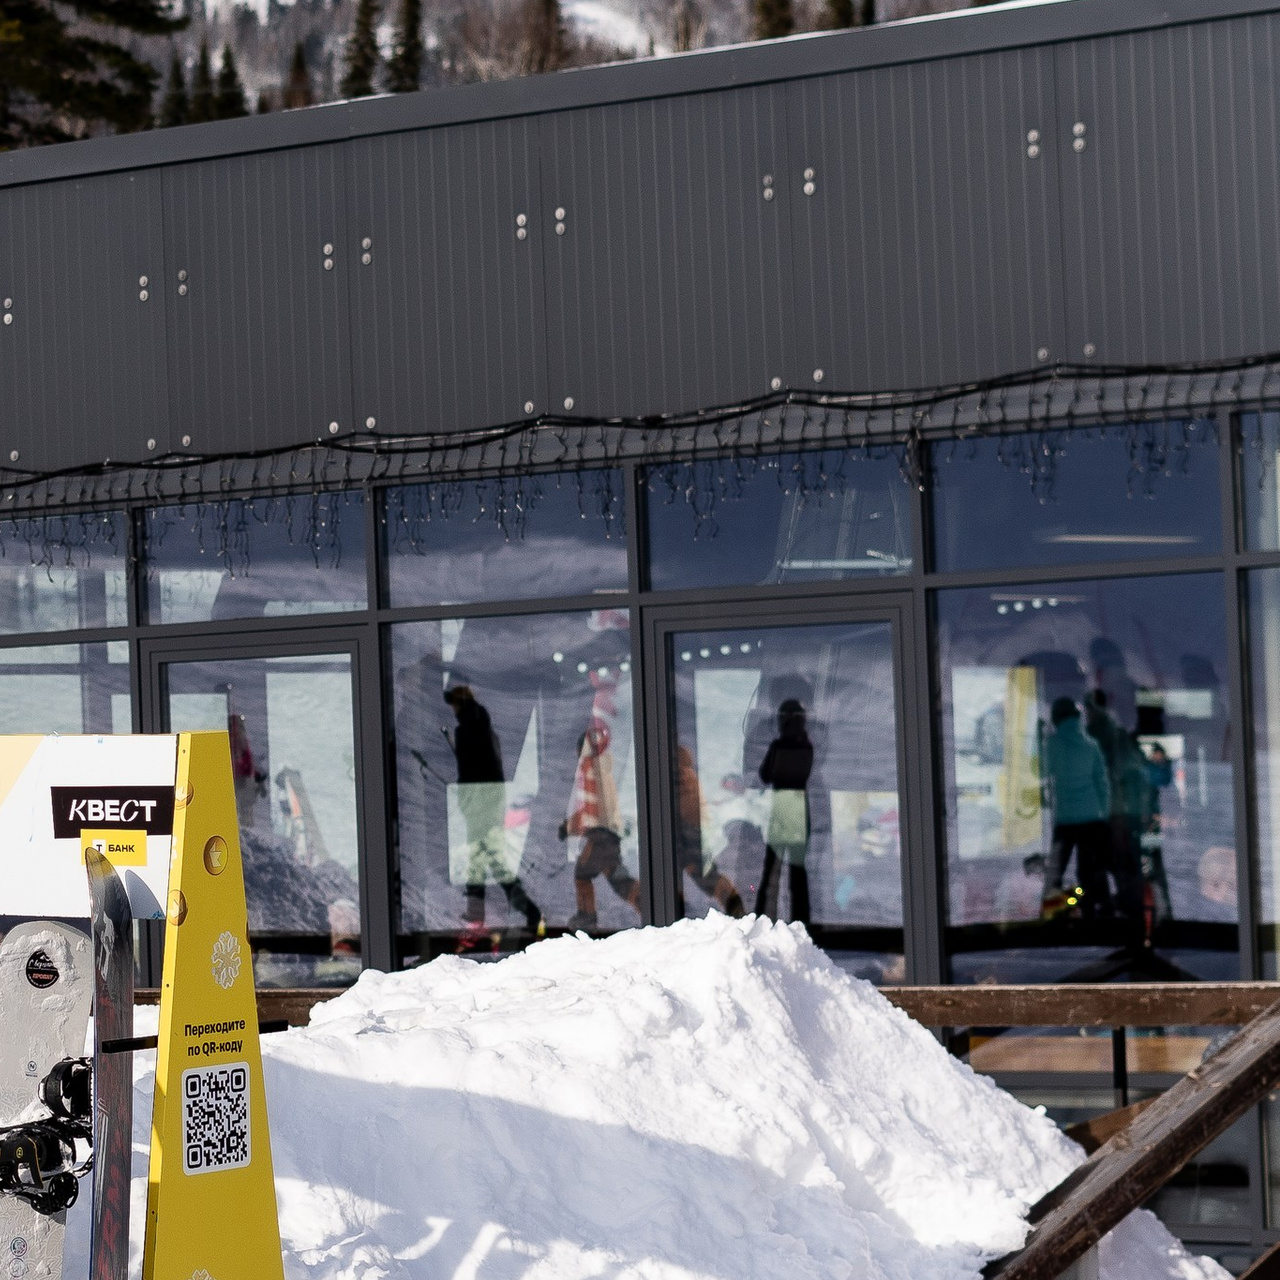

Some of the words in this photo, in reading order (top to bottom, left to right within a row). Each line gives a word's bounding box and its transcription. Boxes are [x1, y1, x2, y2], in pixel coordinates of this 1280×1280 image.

[68, 799, 157, 822] КВЕСТ
[108, 844, 135, 853] БАНК
[184, 1020, 246, 1038] Переходите
[187, 1045, 201, 1057] по
[202, 1040, 243, 1058] QR-коду
